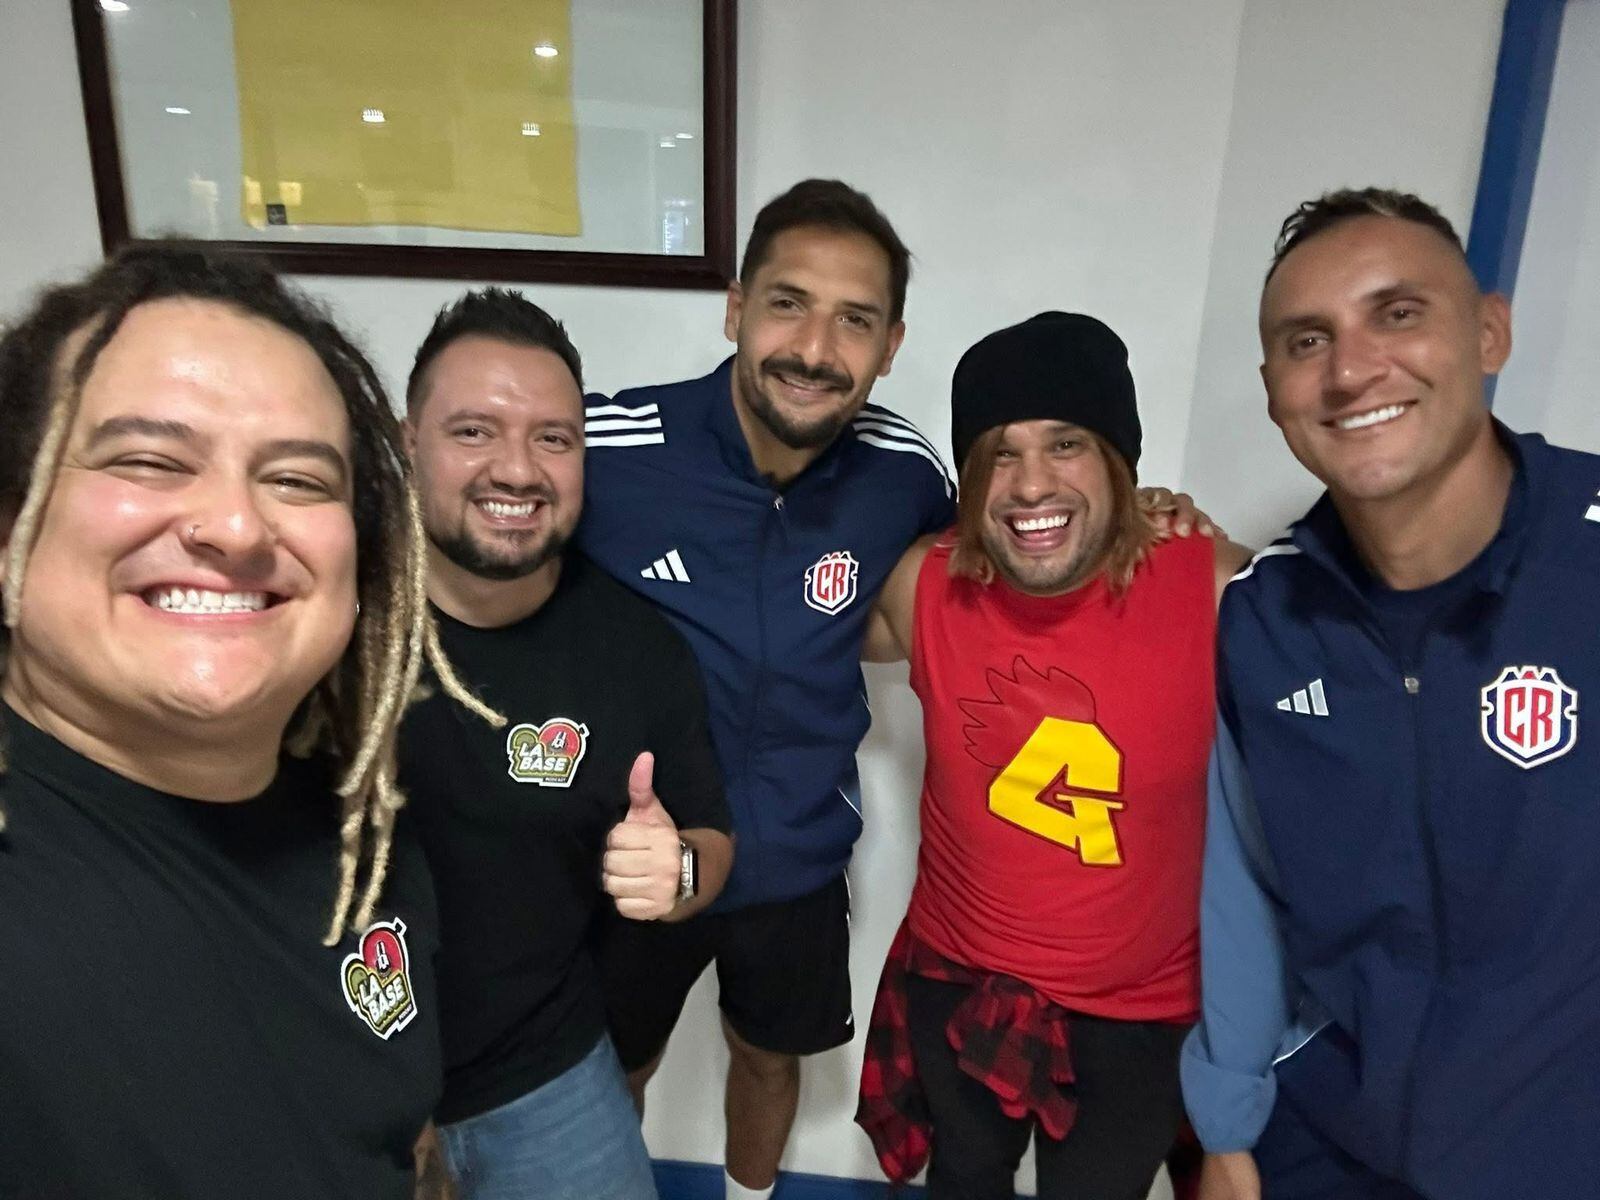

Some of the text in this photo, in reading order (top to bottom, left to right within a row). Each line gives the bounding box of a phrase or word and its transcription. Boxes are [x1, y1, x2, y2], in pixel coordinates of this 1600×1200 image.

[817, 563, 846, 601] CR
[1504, 687, 1554, 748] CR
[520, 743, 542, 757] LA
[520, 757, 568, 772] BASE
[360, 974, 381, 1006] LA
[368, 976, 405, 1023] BASE
